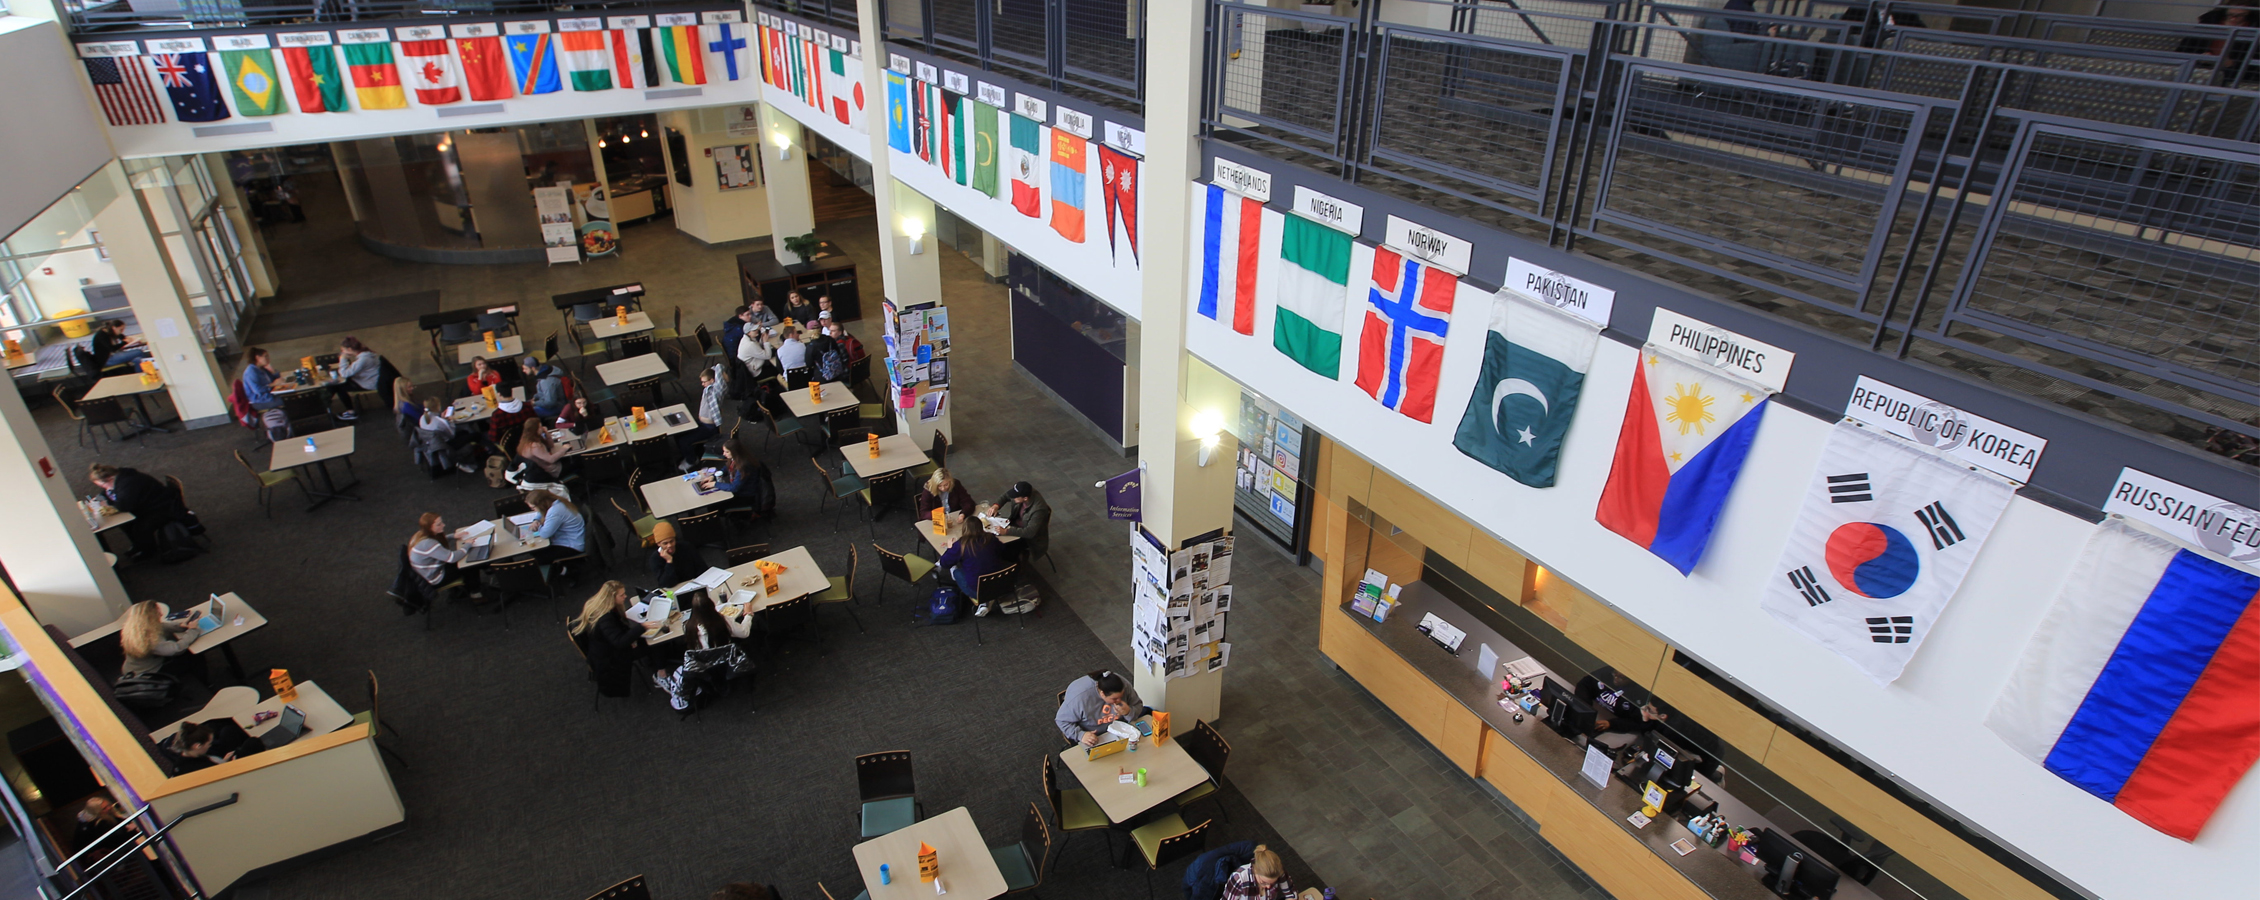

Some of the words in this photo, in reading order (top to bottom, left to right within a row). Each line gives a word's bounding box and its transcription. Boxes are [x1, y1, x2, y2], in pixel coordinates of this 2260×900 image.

[1217, 164, 1267, 194] NETHERLANDS
[1310, 197, 1343, 223] NIGERIA
[1407, 229, 1448, 257] NORWAY
[1526, 272, 1588, 309] PAKISTAN
[1670, 324, 1766, 374] PHILIPPINES
[1851, 386, 1938, 432] REPUBLIC
[1940, 419, 1968, 441] OF
[1967, 428, 2037, 470] KOREA
[1110, 505, 1139, 513] Information
[2115, 481, 2216, 531] RUSSIAN
